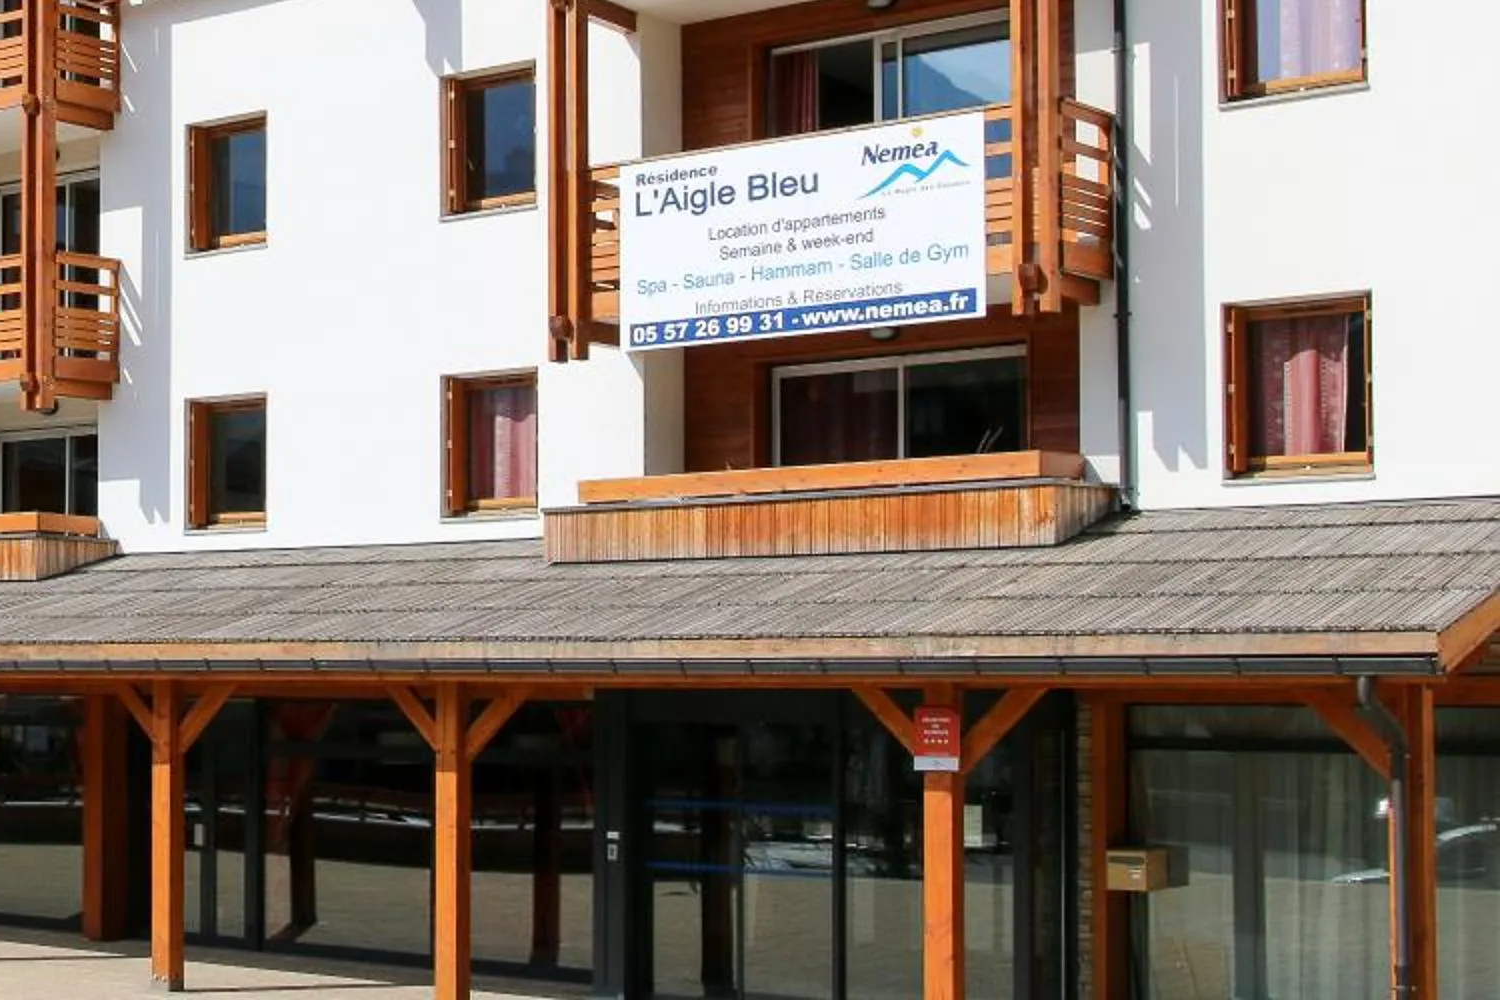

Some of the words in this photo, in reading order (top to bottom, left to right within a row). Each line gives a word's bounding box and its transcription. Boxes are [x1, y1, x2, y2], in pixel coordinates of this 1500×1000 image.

[636, 165, 718, 187] Résidence
[635, 181, 735, 217] L'Aigle
[748, 172, 819, 202] Bleu
[708, 219, 768, 241] Location
[771, 206, 886, 233] d'appartements
[719, 242, 783, 261] Semaine
[787, 236, 797, 252] &
[801, 228, 875, 251] week-end
[637, 279, 667, 296] Spa
[683, 269, 735, 290] Sauna
[751, 260, 833, 282] Hammam
[850, 252, 893, 271] Salle
[899, 248, 921, 265] de
[927, 243, 969, 265] Gym
[633, 326, 657, 344] 05
[663, 322, 688, 341] 57
[695, 319, 720, 337] 26
[726, 315, 752, 334] 99
[759, 311, 785, 331] 31
[801, 292, 969, 327] www.nemea.fr
[695, 295, 783, 315] Informations
[787, 291, 798, 305] &
